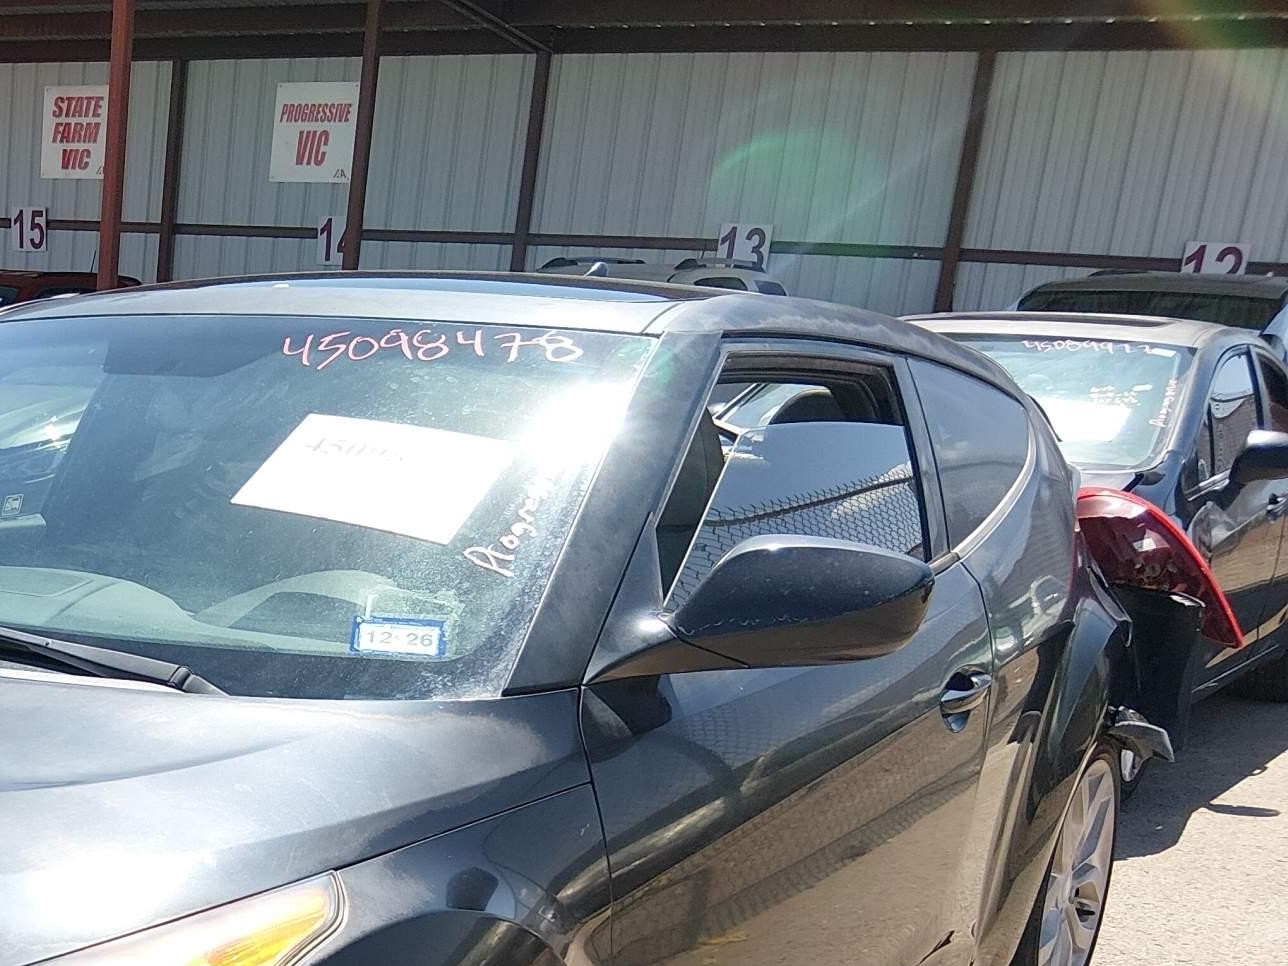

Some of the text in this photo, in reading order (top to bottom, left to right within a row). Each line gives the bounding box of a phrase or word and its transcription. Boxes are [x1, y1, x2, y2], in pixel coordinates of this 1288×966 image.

[52, 96, 105, 118] STATE
[280, 103, 353, 123] PROGRESSIVE
[52, 122, 101, 144] FARM
[295, 129, 330, 167] VIC
[61, 148, 91, 170] VIC
[13, 209, 45, 250] 15
[720, 226, 766, 271] 13
[282, 329, 585, 369] 45098478
